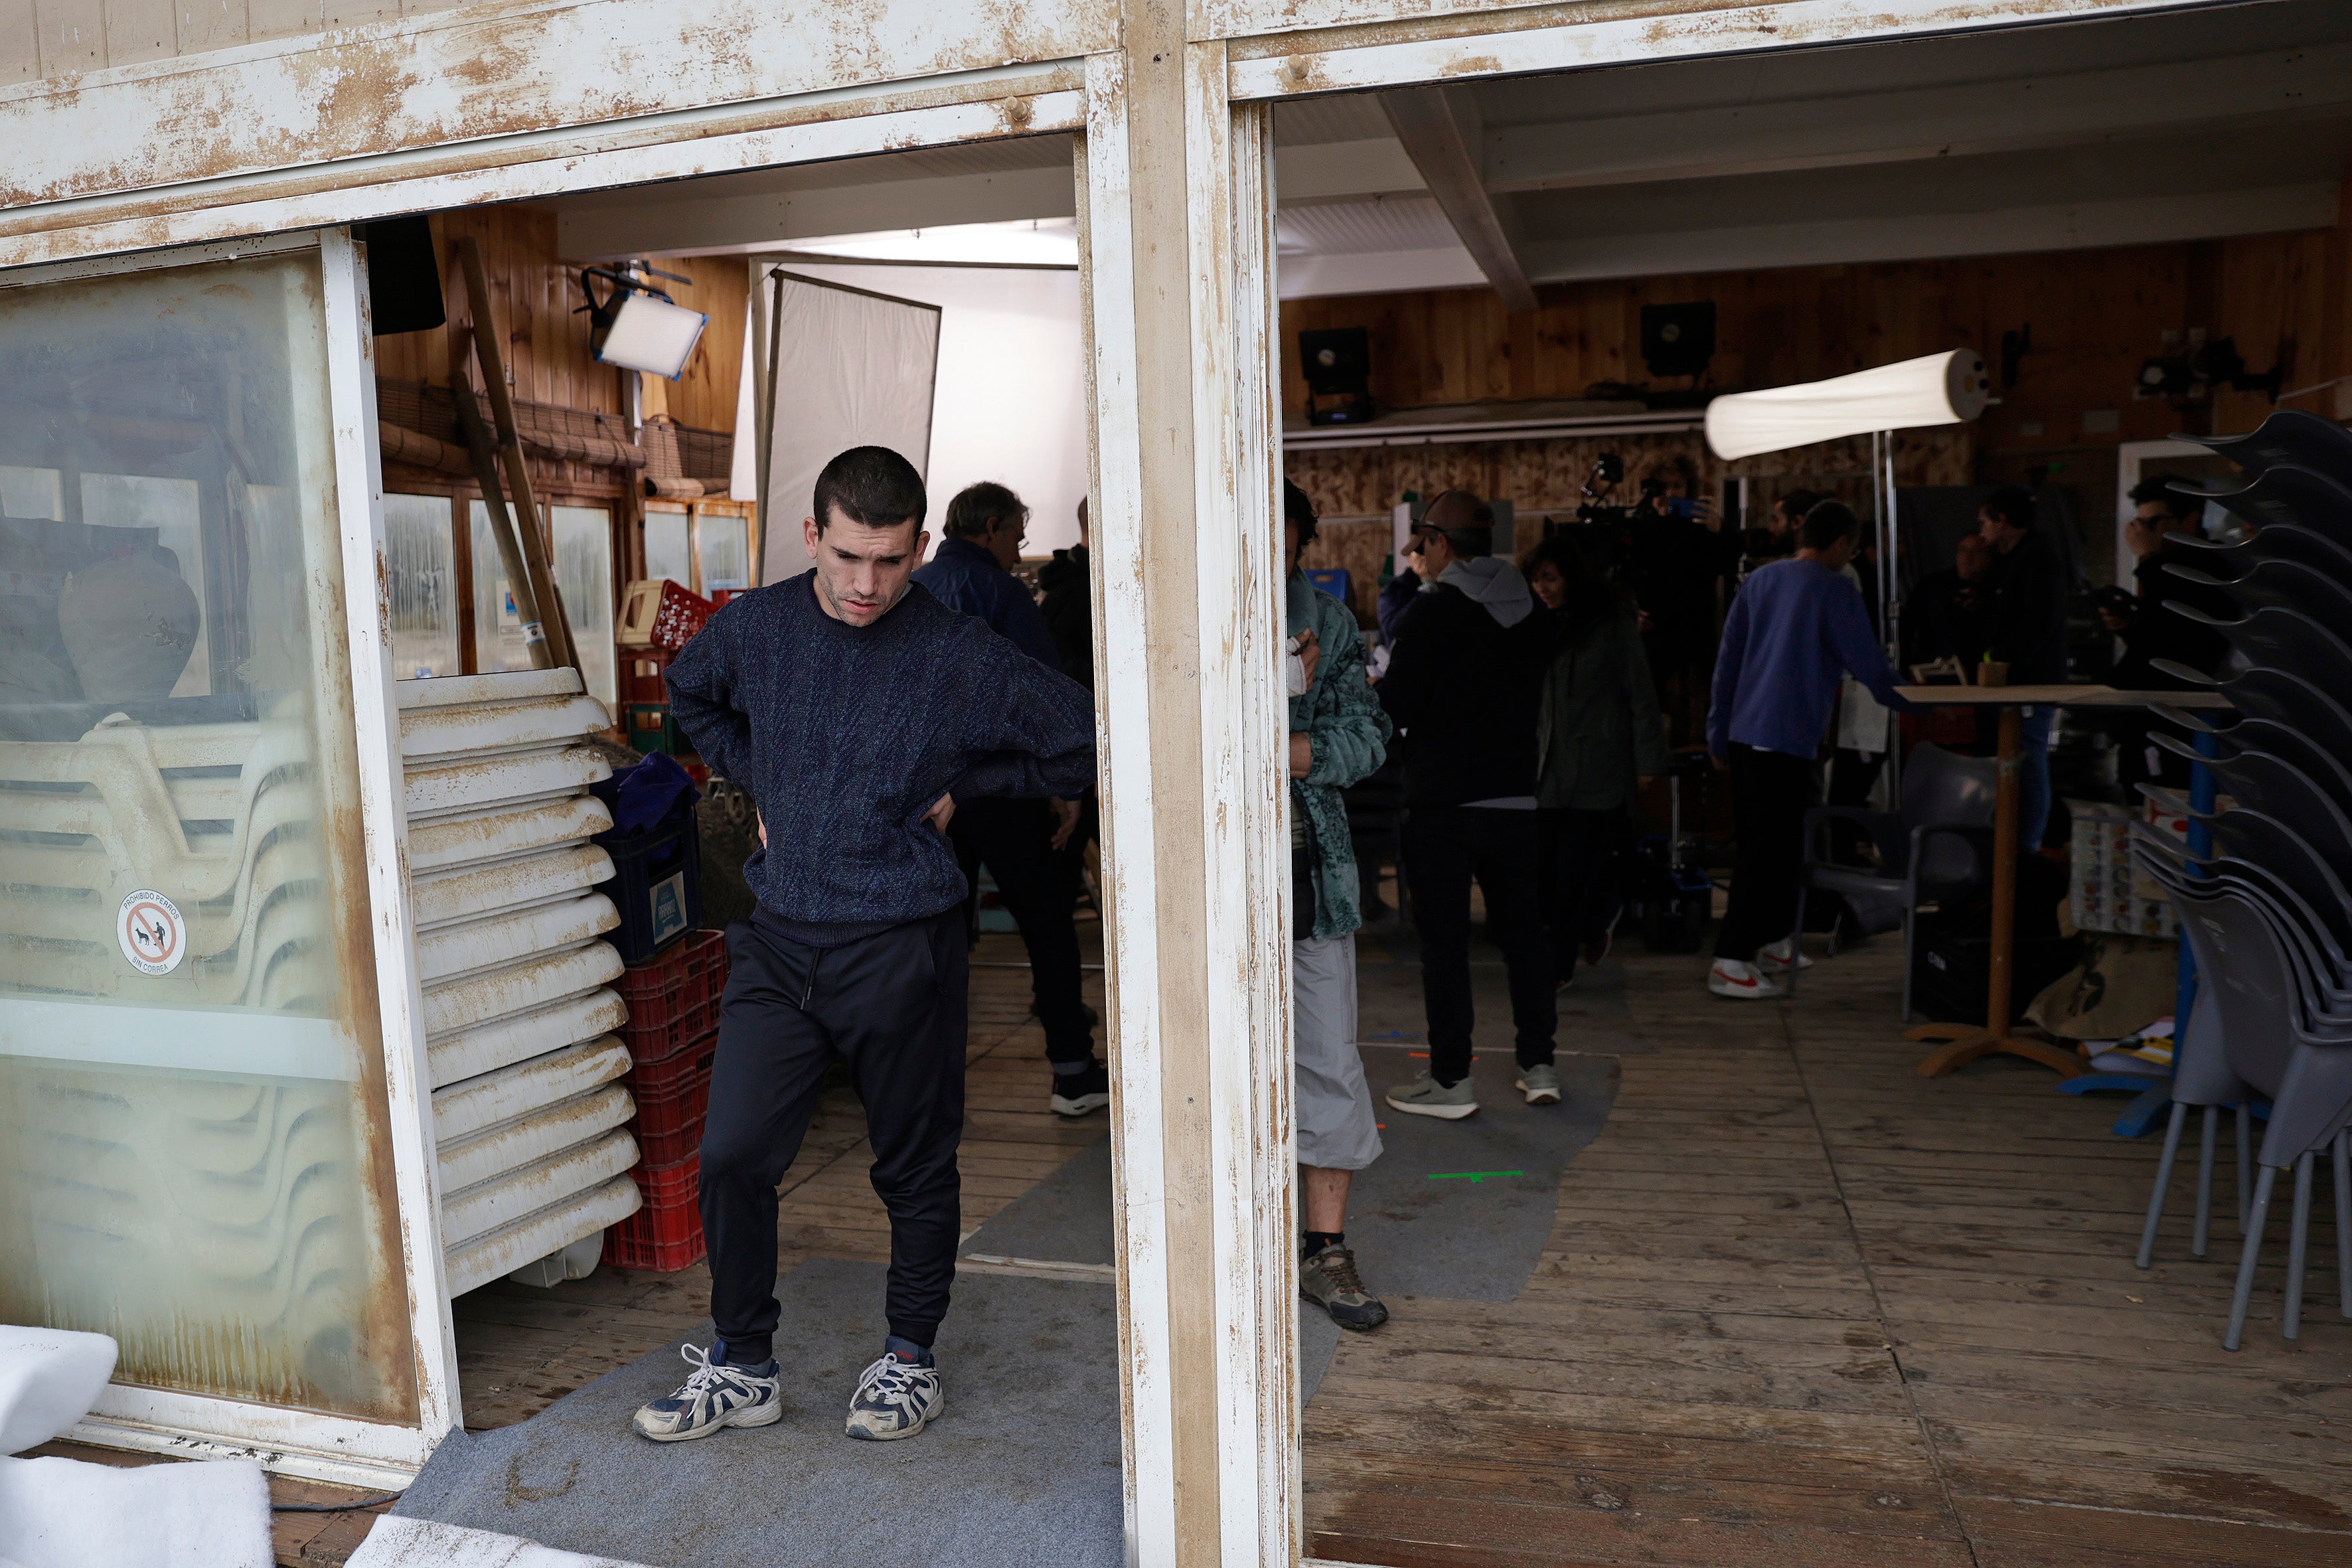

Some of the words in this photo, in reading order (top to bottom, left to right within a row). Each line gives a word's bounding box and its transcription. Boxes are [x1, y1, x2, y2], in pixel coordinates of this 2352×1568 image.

[123, 892, 154, 909] PROHIBIDO
[155, 895, 179, 919] PERROS
[132, 956, 143, 967] SIN
[143, 963, 169, 973] CORREA
